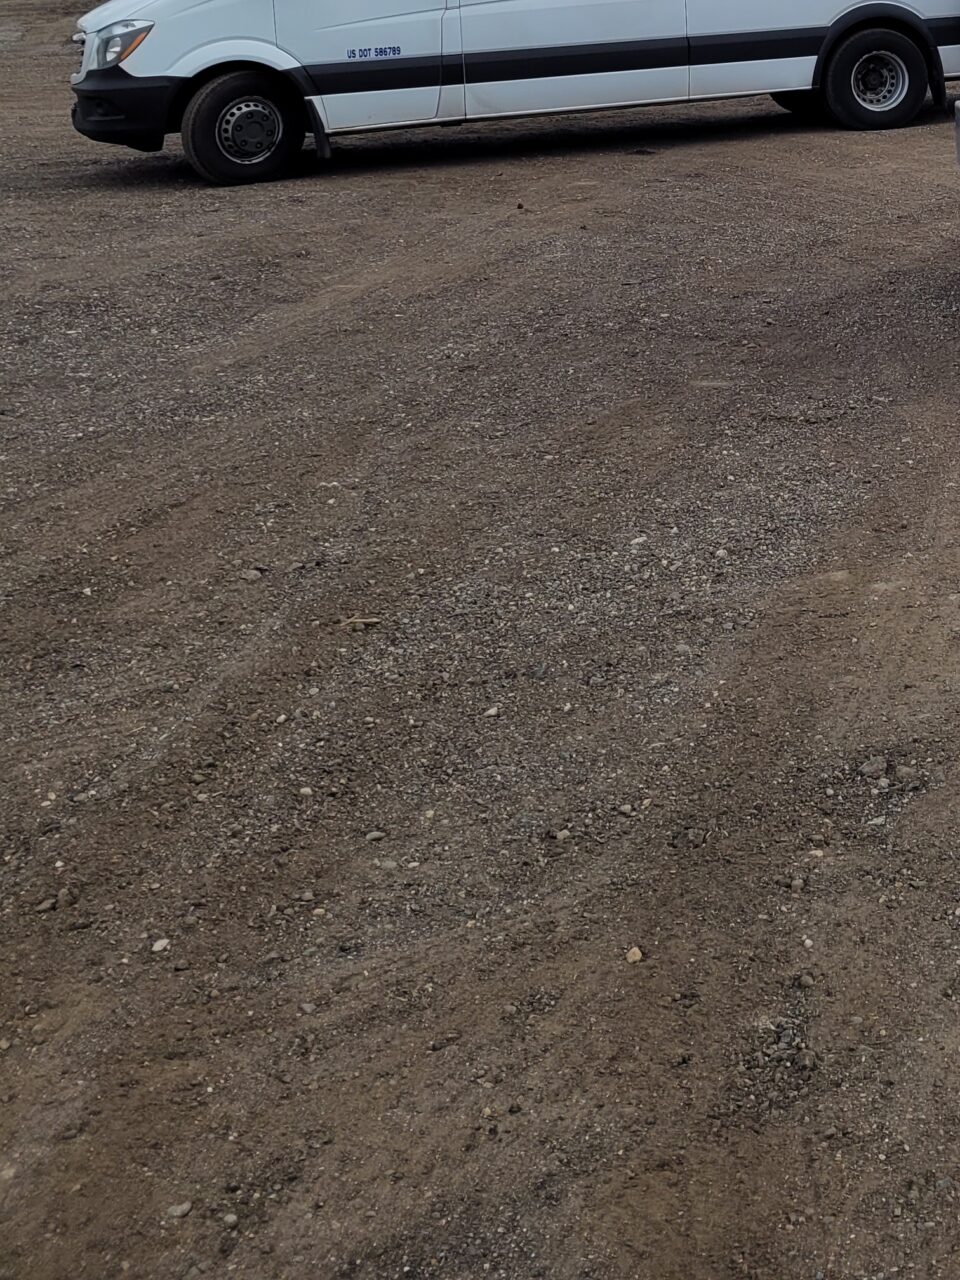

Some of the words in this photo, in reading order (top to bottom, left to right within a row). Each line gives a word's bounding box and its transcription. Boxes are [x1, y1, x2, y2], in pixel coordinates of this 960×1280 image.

[347, 49, 357, 59] US
[358, 47, 372, 58] DOT
[374, 46, 401, 57] 586789
